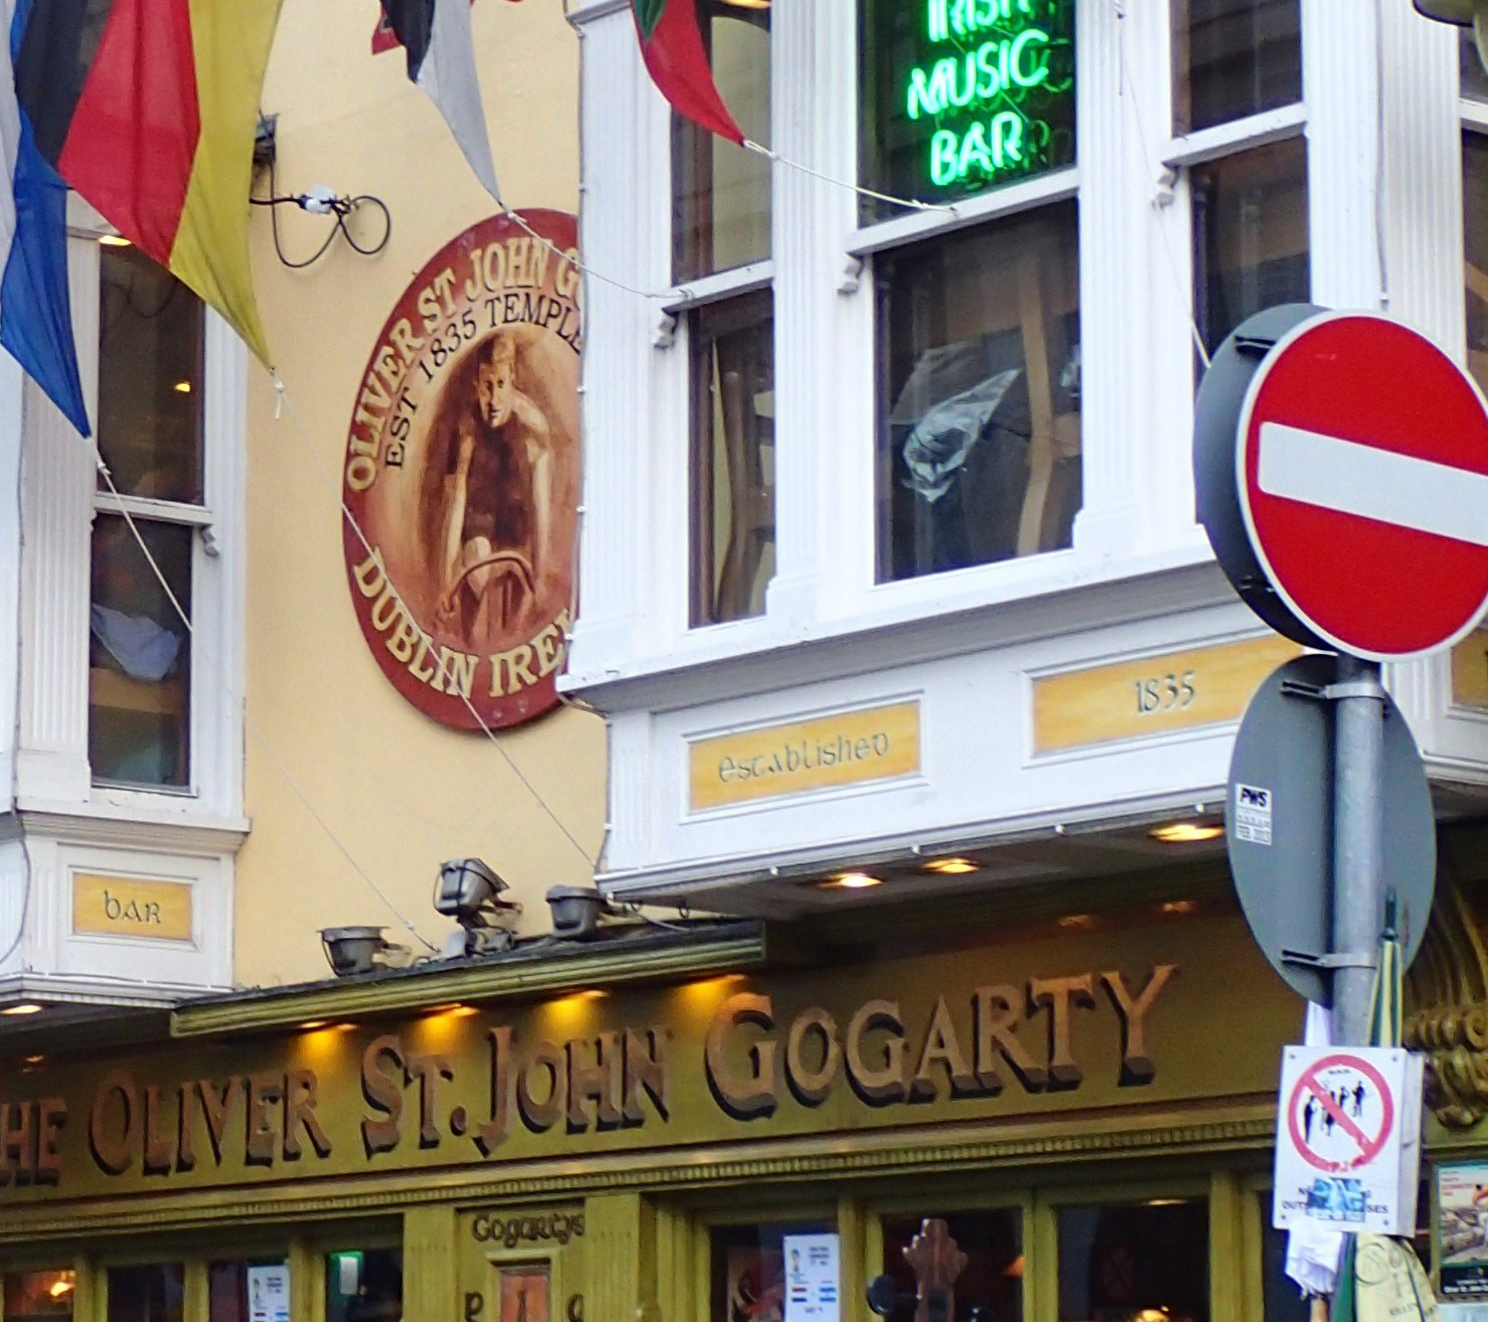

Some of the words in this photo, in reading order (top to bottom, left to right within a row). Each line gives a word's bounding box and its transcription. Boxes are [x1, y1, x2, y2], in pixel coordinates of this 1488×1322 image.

[906, 28, 1050, 120] MUSIC
[930, 110, 1023, 186] BAR
[346, 315, 426, 493] OLIVER
[416, 268, 459, 337] ST
[464, 235, 554, 305] JOHN
[384, 394, 419, 473] EST
[416, 306, 479, 384] 1835
[353, 545, 480, 699] DUBLIN
[1135, 670, 1198, 716] 1835
[88, 1069, 334, 1179] OLIVER
[468, 1021, 672, 1160] JOHN
[703, 962, 1184, 1122] GOGARTY
